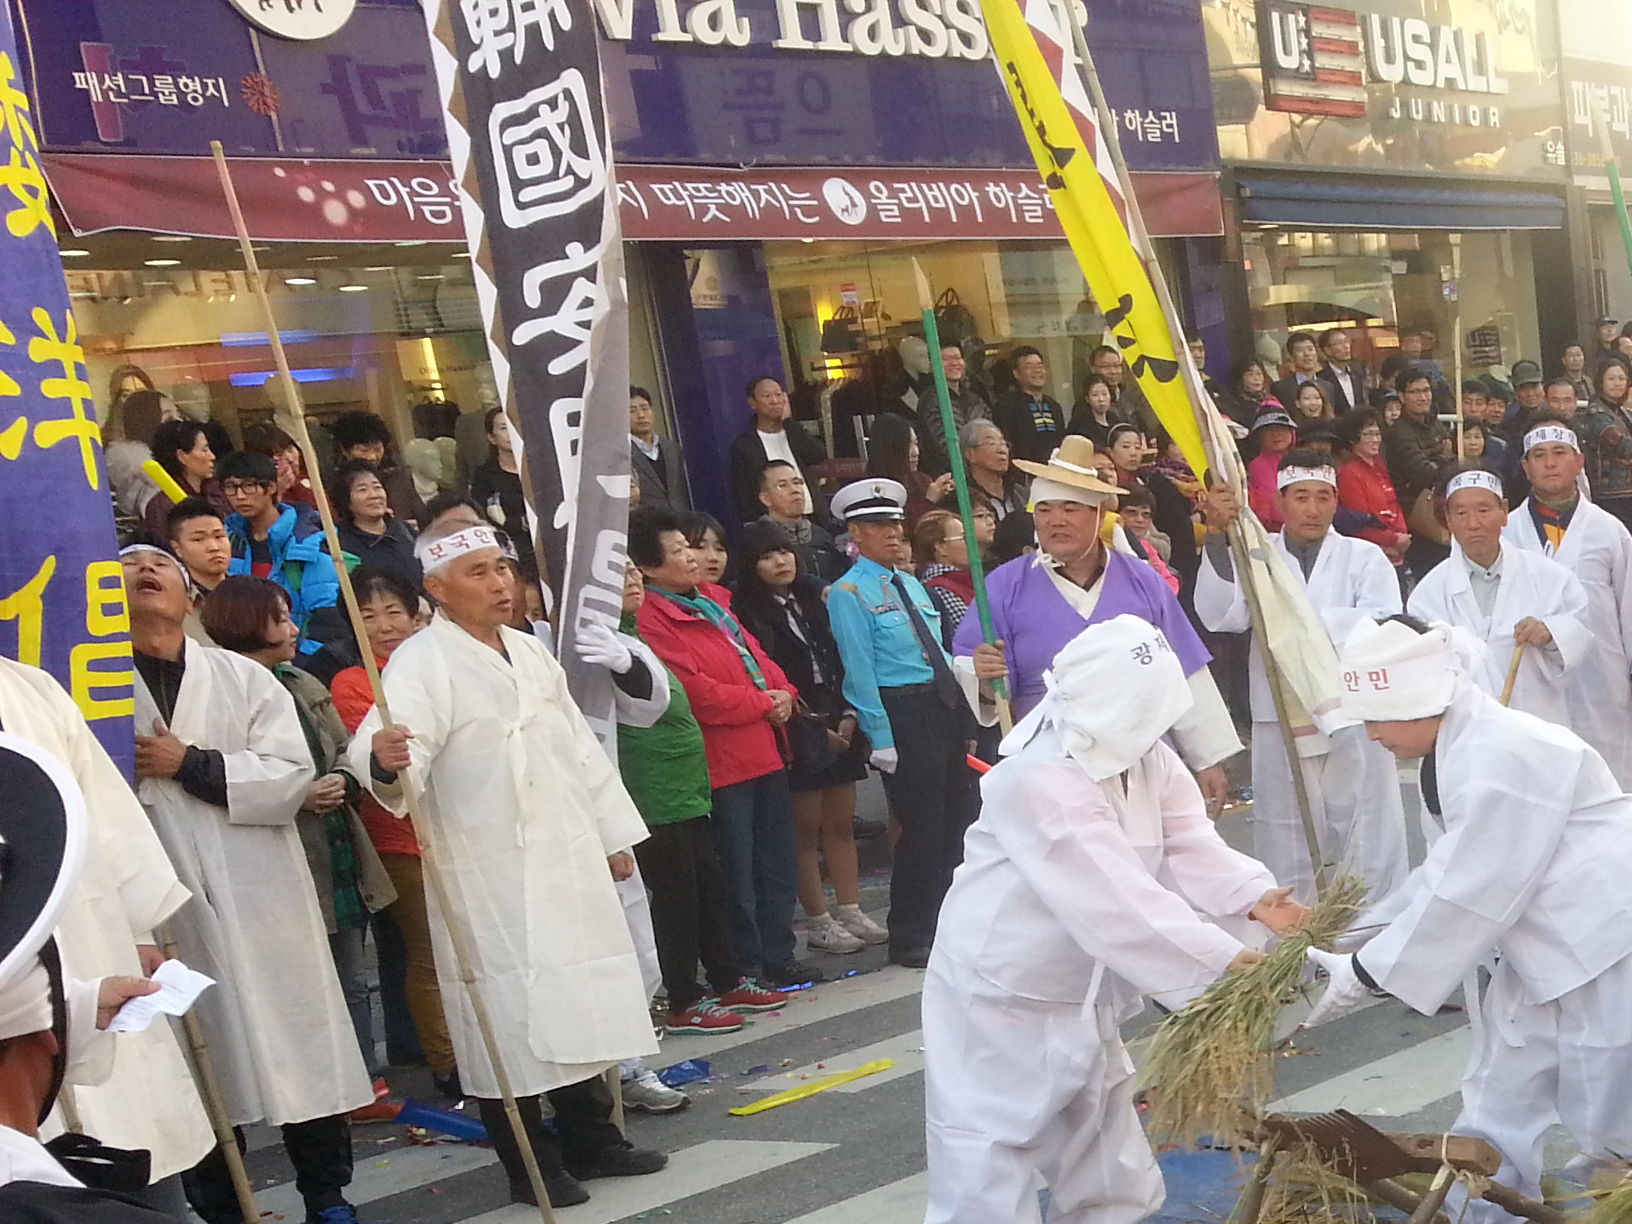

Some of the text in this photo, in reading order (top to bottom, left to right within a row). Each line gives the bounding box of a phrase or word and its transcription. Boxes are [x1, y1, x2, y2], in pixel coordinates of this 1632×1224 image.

[1370, 13, 1508, 95] USALL
[72, 71, 230, 107] 패션그룹형지
[1124, 110, 1180, 143] 하슬러
[1388, 97, 1500, 128] JUNIOR
[649, 181, 820, 224] 따뜻해지는
[869, 178, 982, 224] 올리비아
